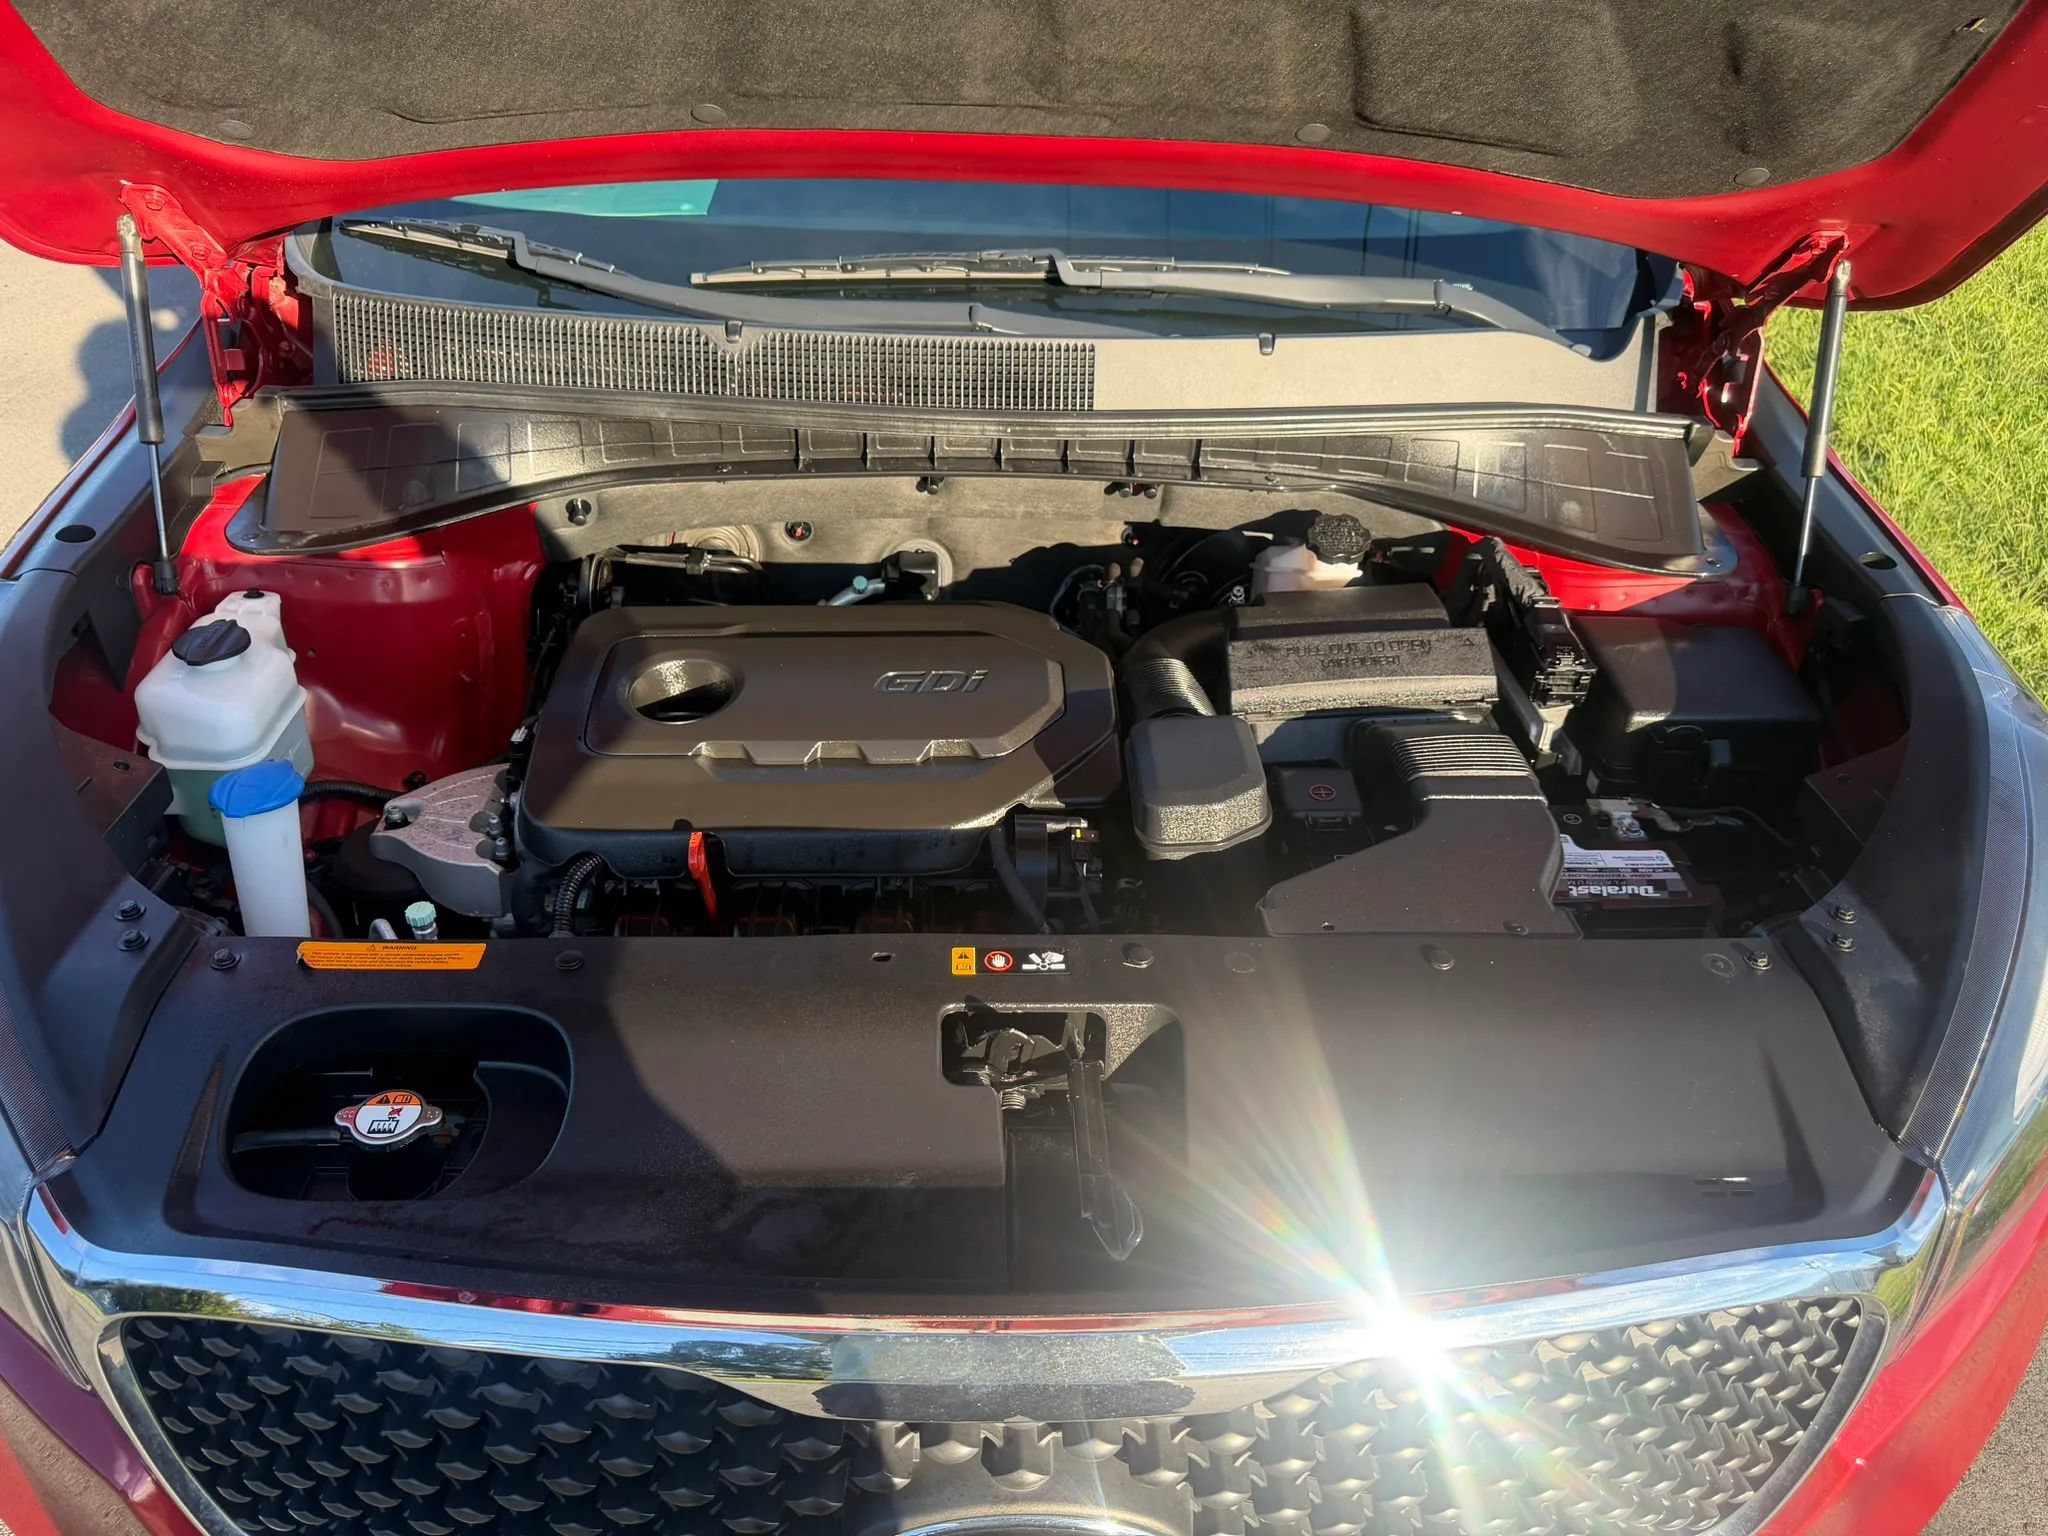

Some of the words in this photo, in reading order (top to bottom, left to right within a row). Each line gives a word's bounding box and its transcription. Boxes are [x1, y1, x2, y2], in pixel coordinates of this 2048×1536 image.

[1286, 644, 1322, 656] PULL
[1328, 642, 1358, 654] OUT
[1367, 640, 1384, 652] TO
[1389, 639, 1432, 652] OPEN
[871, 669, 989, 693] GDi
[1568, 885, 1661, 897] Duralast
